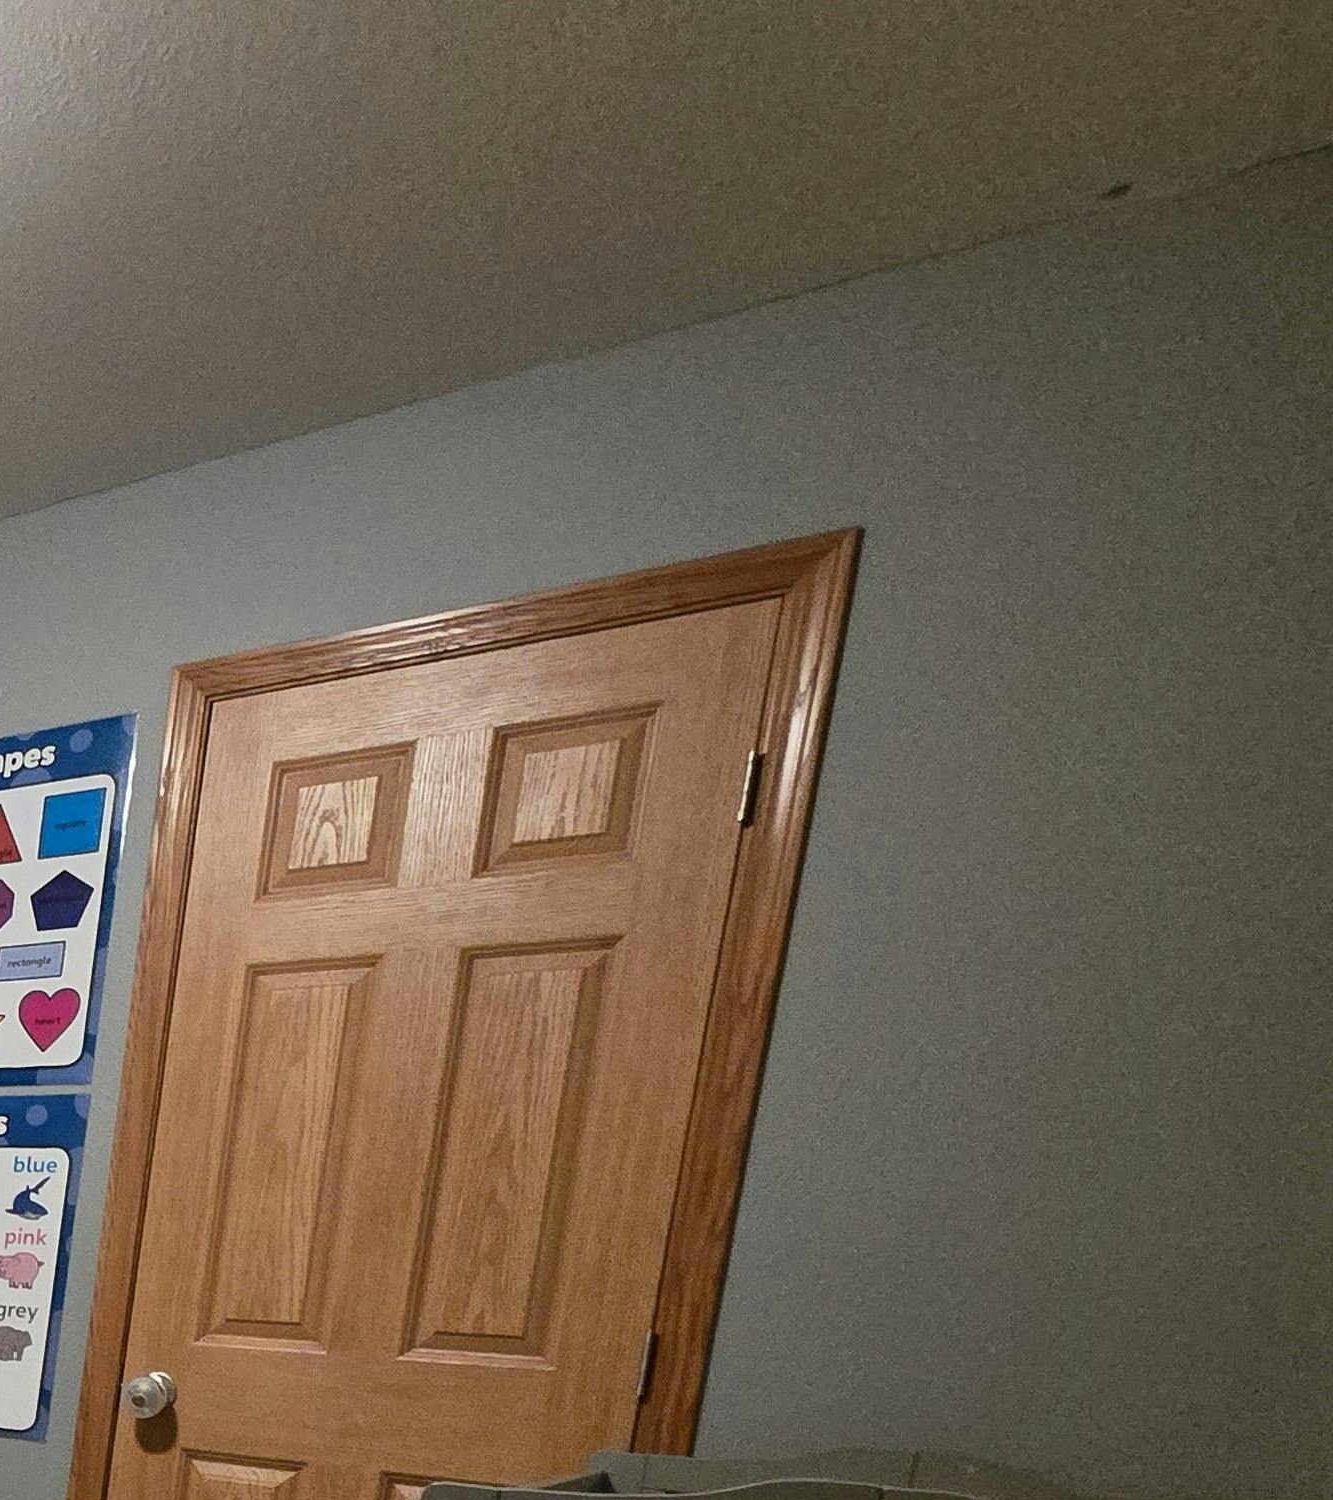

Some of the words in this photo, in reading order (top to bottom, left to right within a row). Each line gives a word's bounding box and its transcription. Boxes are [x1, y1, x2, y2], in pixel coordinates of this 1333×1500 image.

[7, 956, 52, 968] rectangle
[13, 1156, 58, 1173] blue
[4, 1228, 48, 1249] pink
